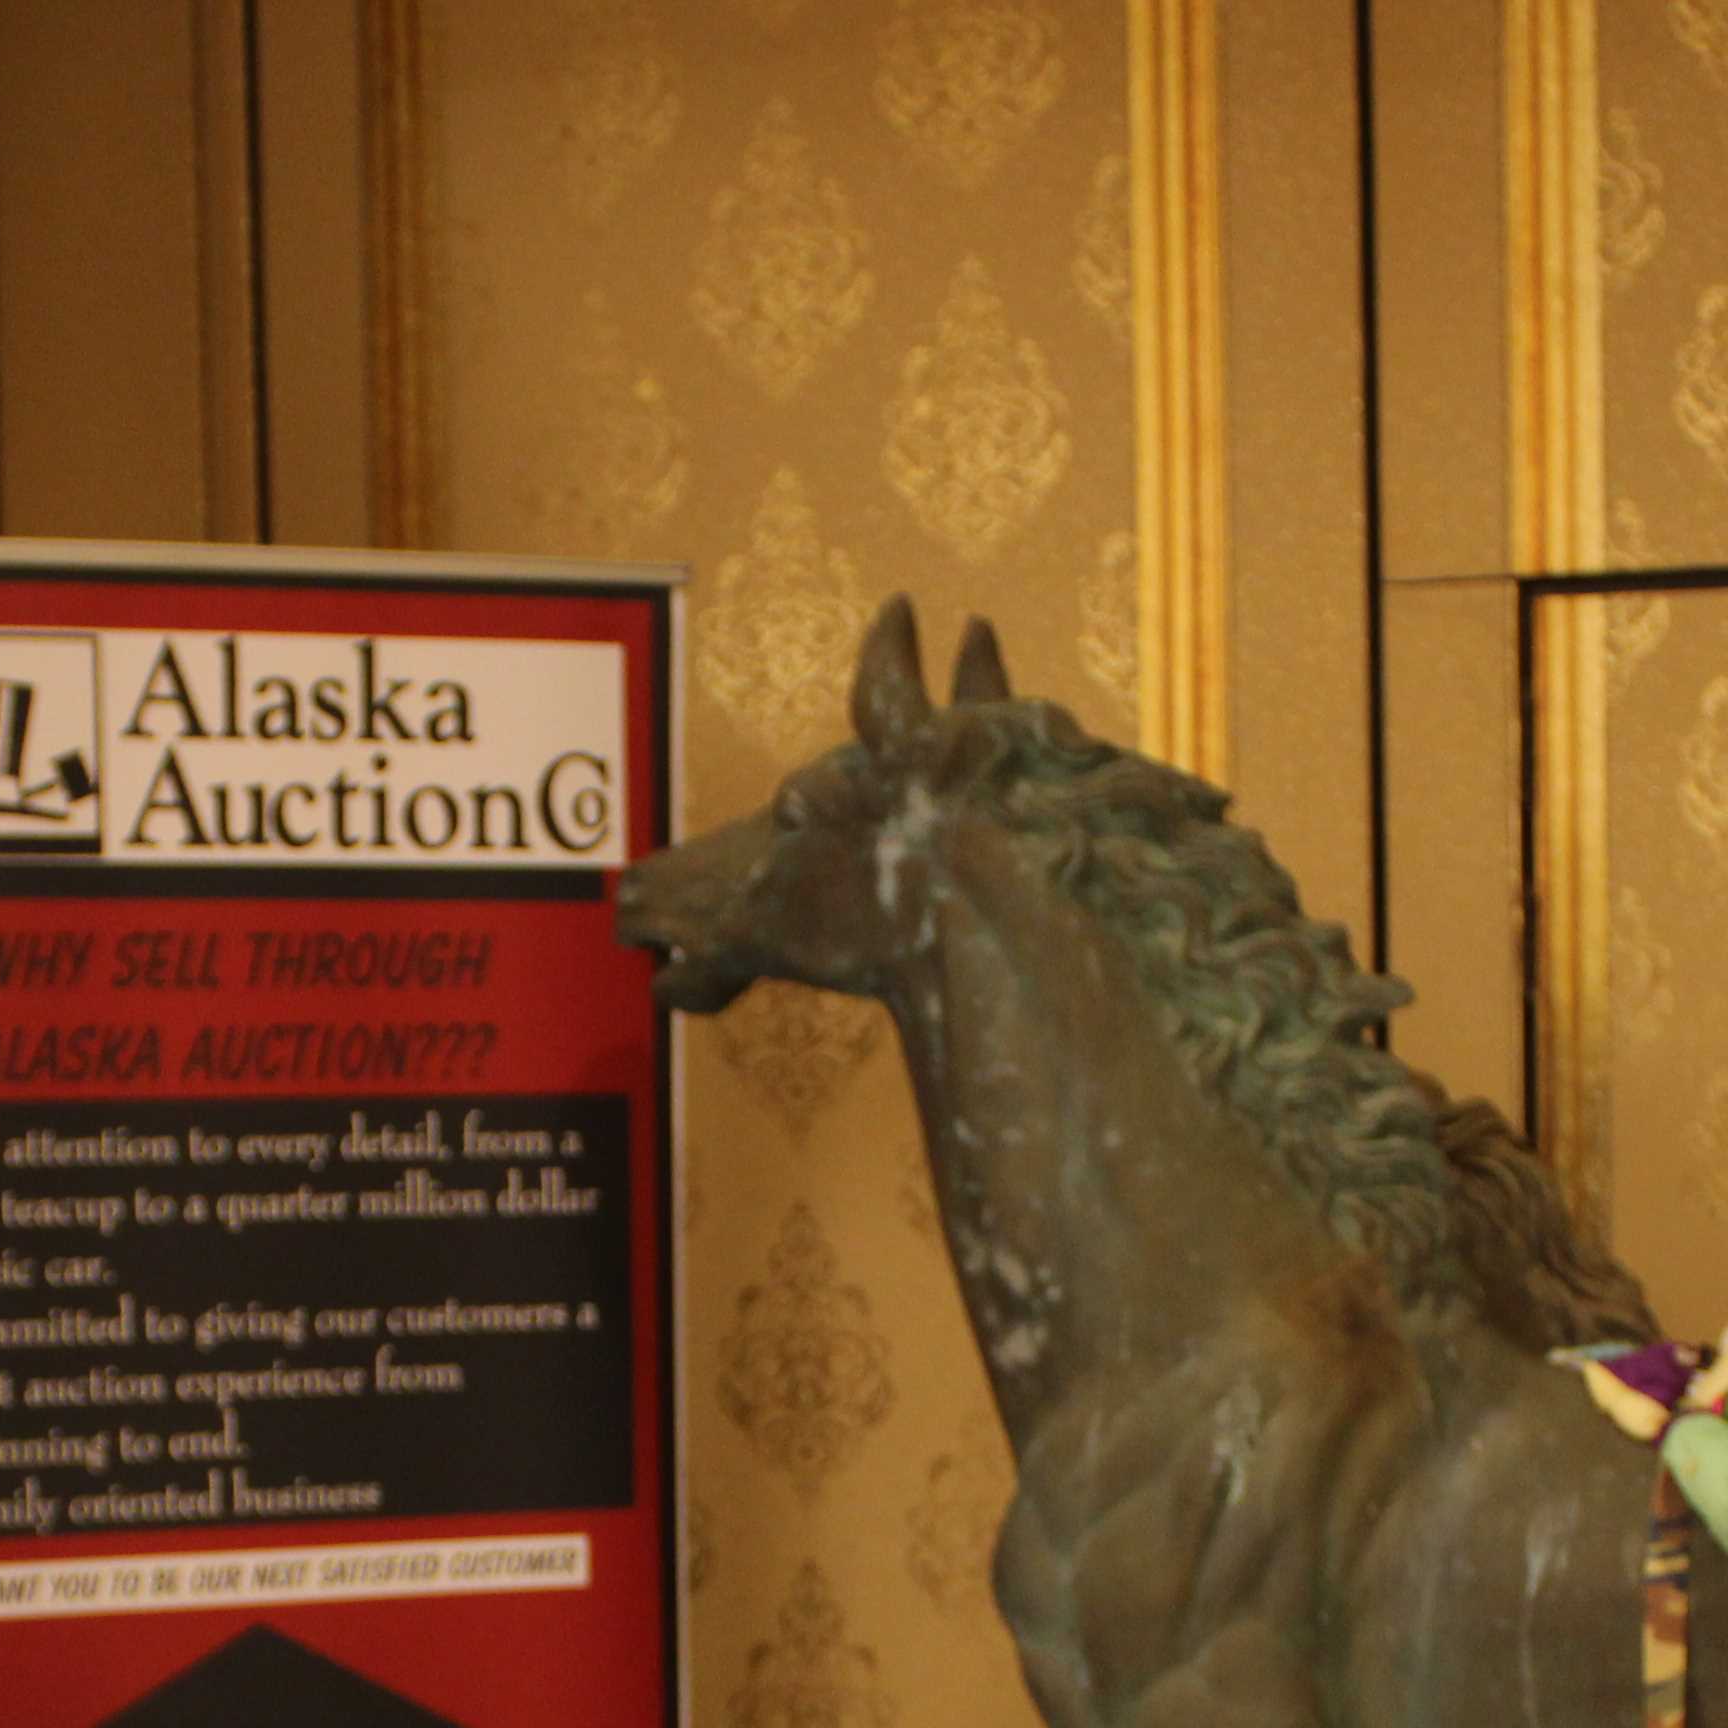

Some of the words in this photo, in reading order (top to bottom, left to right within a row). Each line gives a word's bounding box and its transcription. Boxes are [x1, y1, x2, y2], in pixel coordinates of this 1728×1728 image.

[122, 634, 478, 742] Alaska
[113, 932, 222, 990] SELL
[247, 931, 494, 987] THROUGH
[180, 1023, 499, 1082] AUCTION???
[4, 1126, 177, 1166] attention
[189, 1128, 229, 1163] to
[238, 1128, 330, 1172] every
[462, 1111, 554, 1160] from
[559, 1129, 582, 1159] a
[1, 1190, 124, 1236] teacup
[136, 1187, 174, 1225] to
[182, 1196, 207, 1225] a
[216, 1187, 349, 1233] quarter
[358, 1169, 487, 1220] million
[495, 1168, 599, 1217] dollar
[145, 1307, 183, 1346] to
[195, 1301, 306, 1350] giving
[314, 1307, 378, 1340] our
[387, 1297, 569, 1337] customers
[577, 1301, 599, 1331] a
[24, 1359, 165, 1410] auction
[176, 1355, 364, 1410] experience
[375, 1344, 465, 1395] from
[121, 1426, 159, 1463] to
[69, 1469, 223, 1524] oriented
[232, 1467, 384, 1516] business
[48, 1571, 100, 1604] YOU
[109, 1568, 143, 1601] TO
[151, 1567, 180, 1597] BE
[191, 1564, 243, 1595] OUR
[251, 1559, 308, 1592] NEXT
[318, 1552, 440, 1589] SATISFIED
[449, 1545, 578, 1580] CUSTOMER
